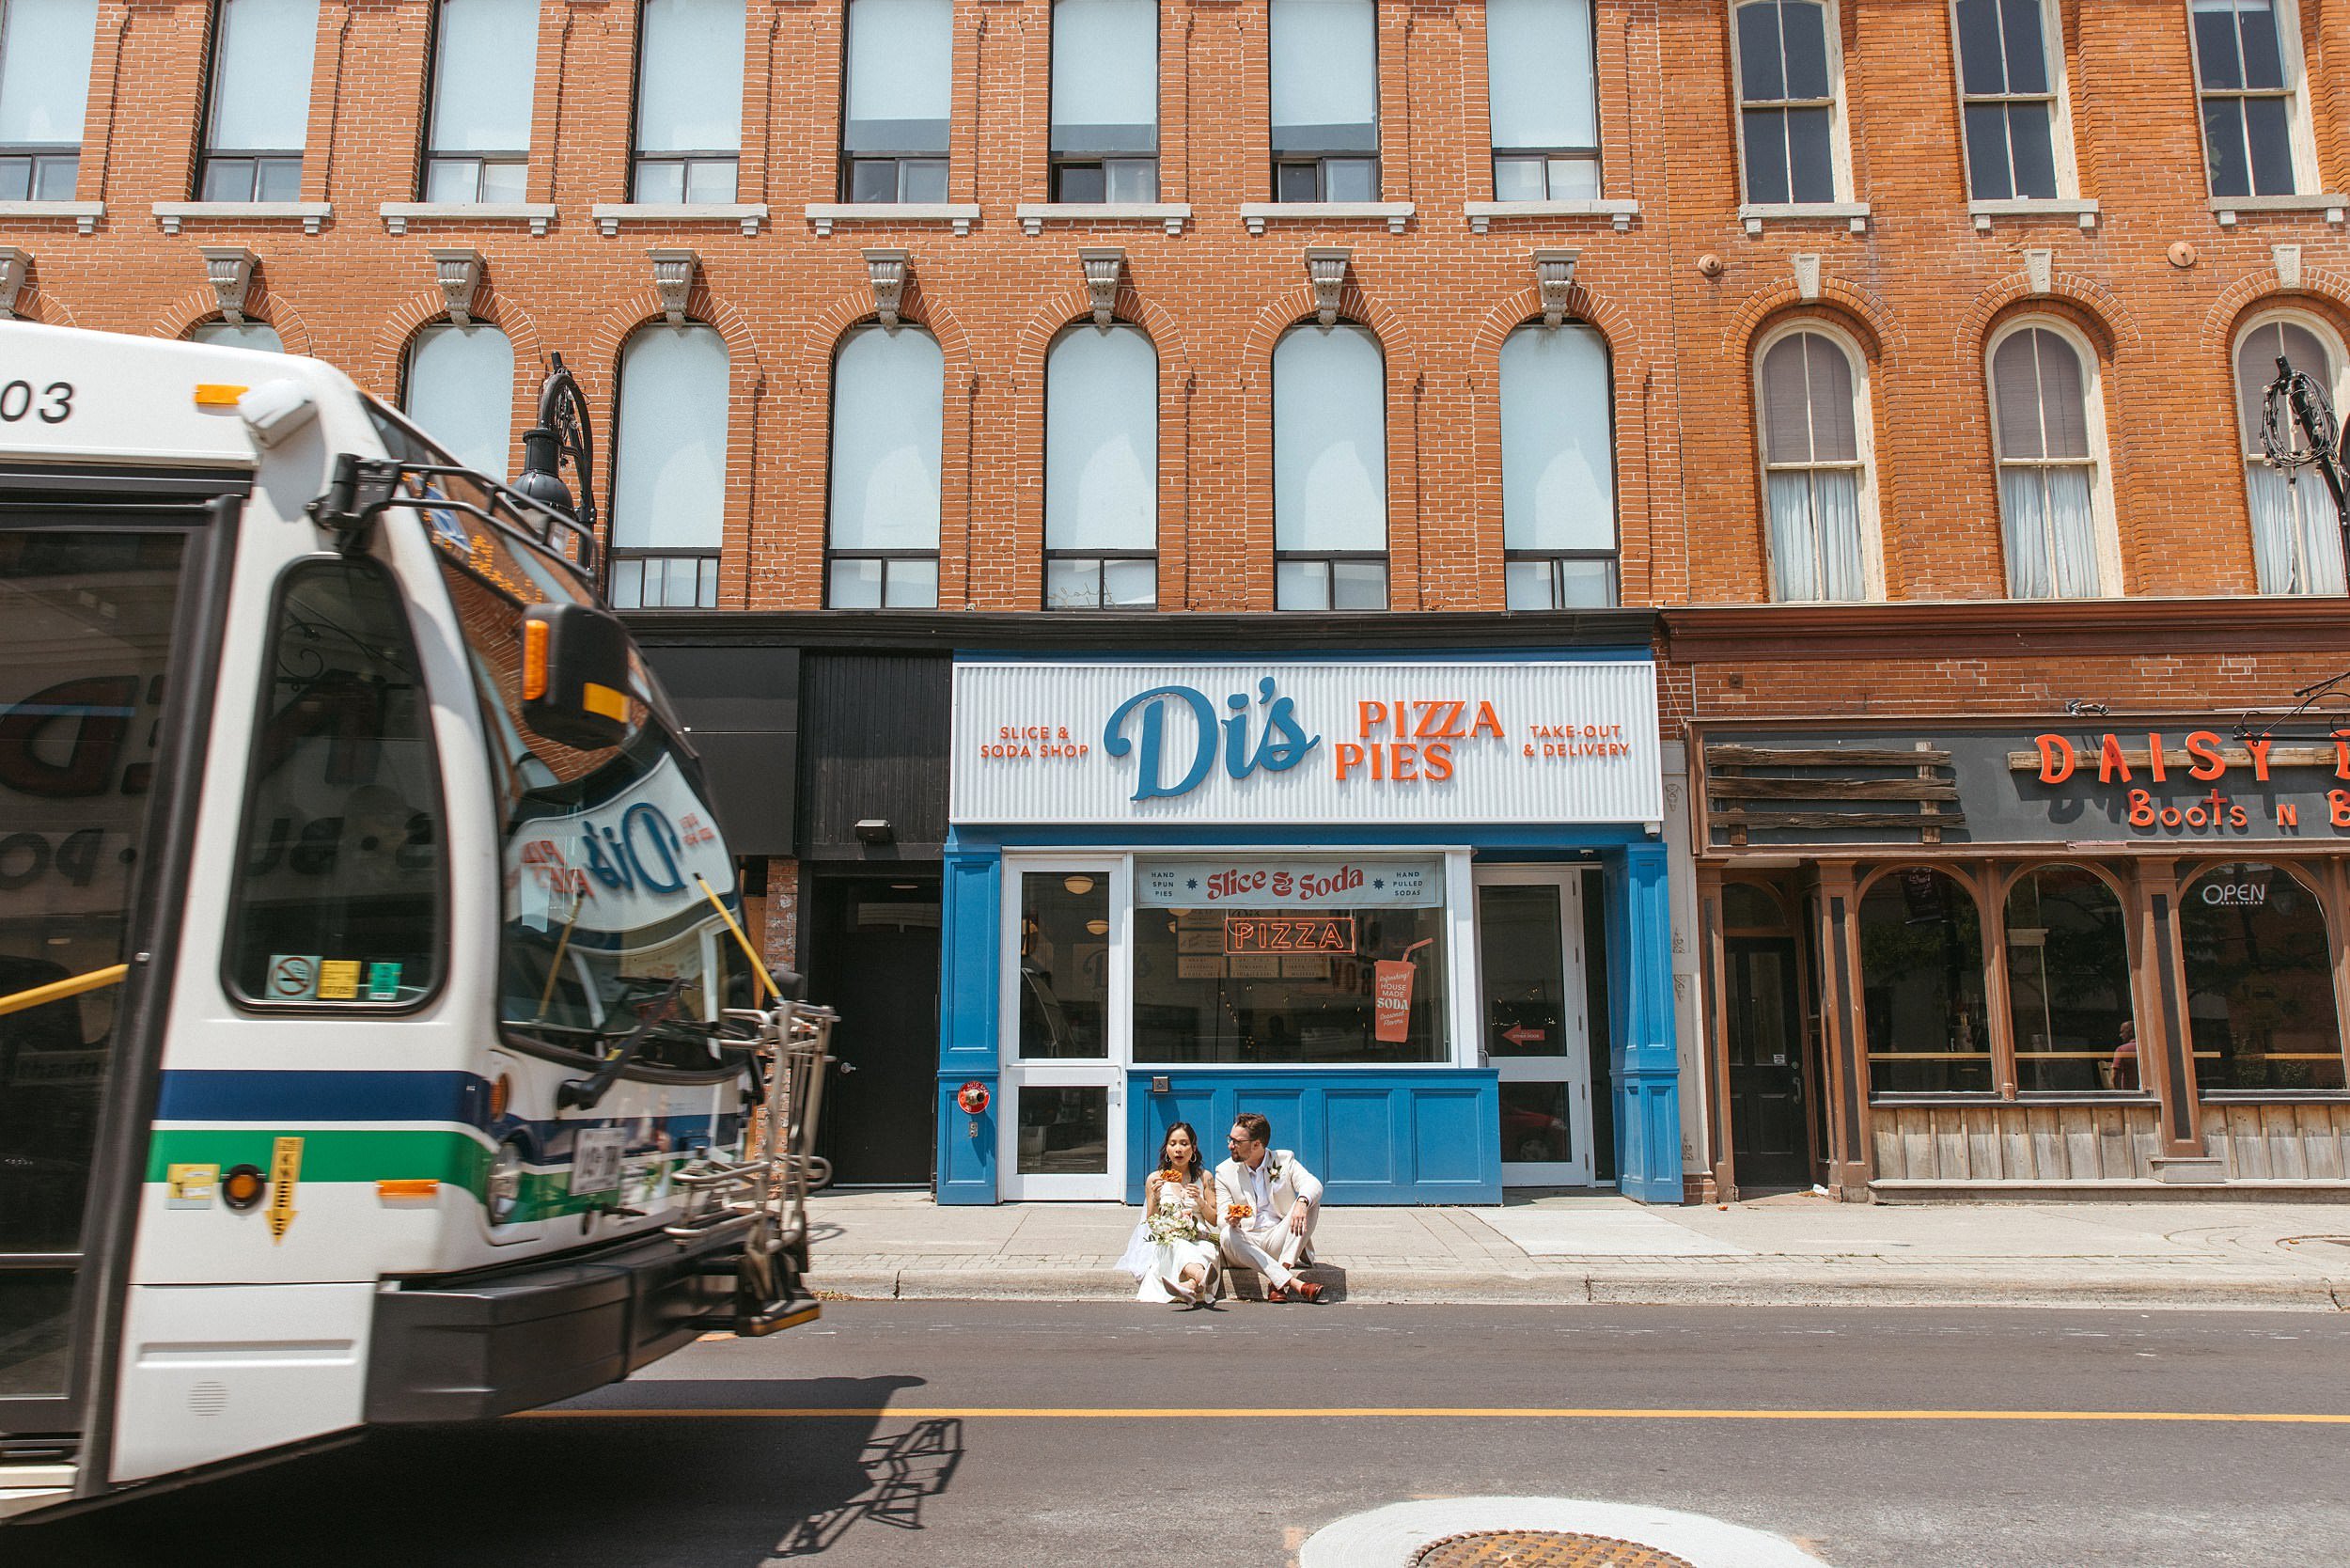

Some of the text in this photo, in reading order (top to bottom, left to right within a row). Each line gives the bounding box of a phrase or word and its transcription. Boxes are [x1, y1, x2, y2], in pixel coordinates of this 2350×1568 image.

[1358, 700, 1505, 738] PIZZA
[999, 727, 1070, 740] SLICE &
[1104, 677, 1321, 801] Di's
[1529, 725, 1622, 738] TAKE-OUT
[980, 745, 1089, 759] SODA SHOP
[1523, 744, 1631, 757] & DELIVERY
[2034, 730, 2273, 784] DAISY
[1335, 743, 1454, 780] PIES
[1207, 865, 1364, 901] Slice & Soda
[2201, 883, 2265, 904] OPEN
[1234, 922, 1344, 949] PIZZA
[1380, 982, 1407, 992] HOUSE
[1382, 990, 1404, 998] MADE
[1377, 997, 1410, 1011] SODA
